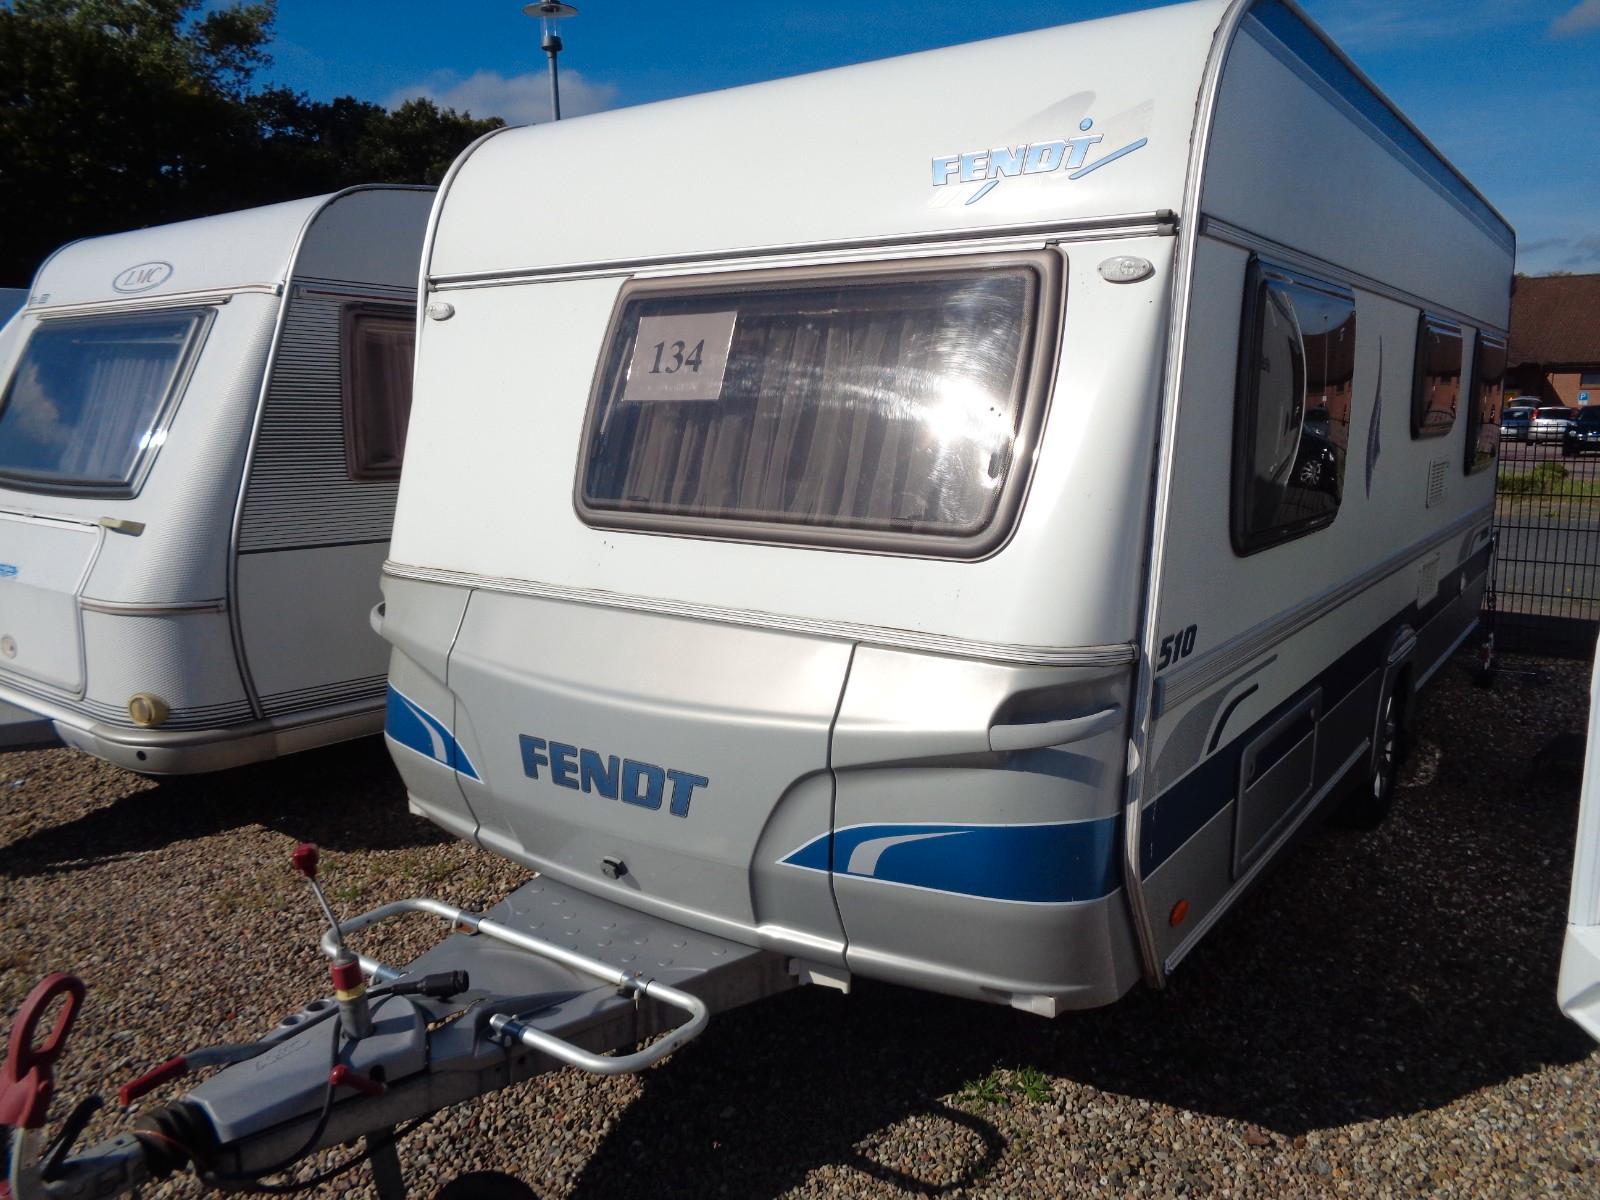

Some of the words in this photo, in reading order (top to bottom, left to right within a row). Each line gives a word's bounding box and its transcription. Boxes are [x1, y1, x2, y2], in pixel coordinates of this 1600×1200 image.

[932, 133, 1104, 187] FENDT
[123, 266, 163, 286] LMC
[648, 339, 705, 374] 134
[1156, 624, 1198, 673] 510
[518, 733, 709, 819] FENDT
